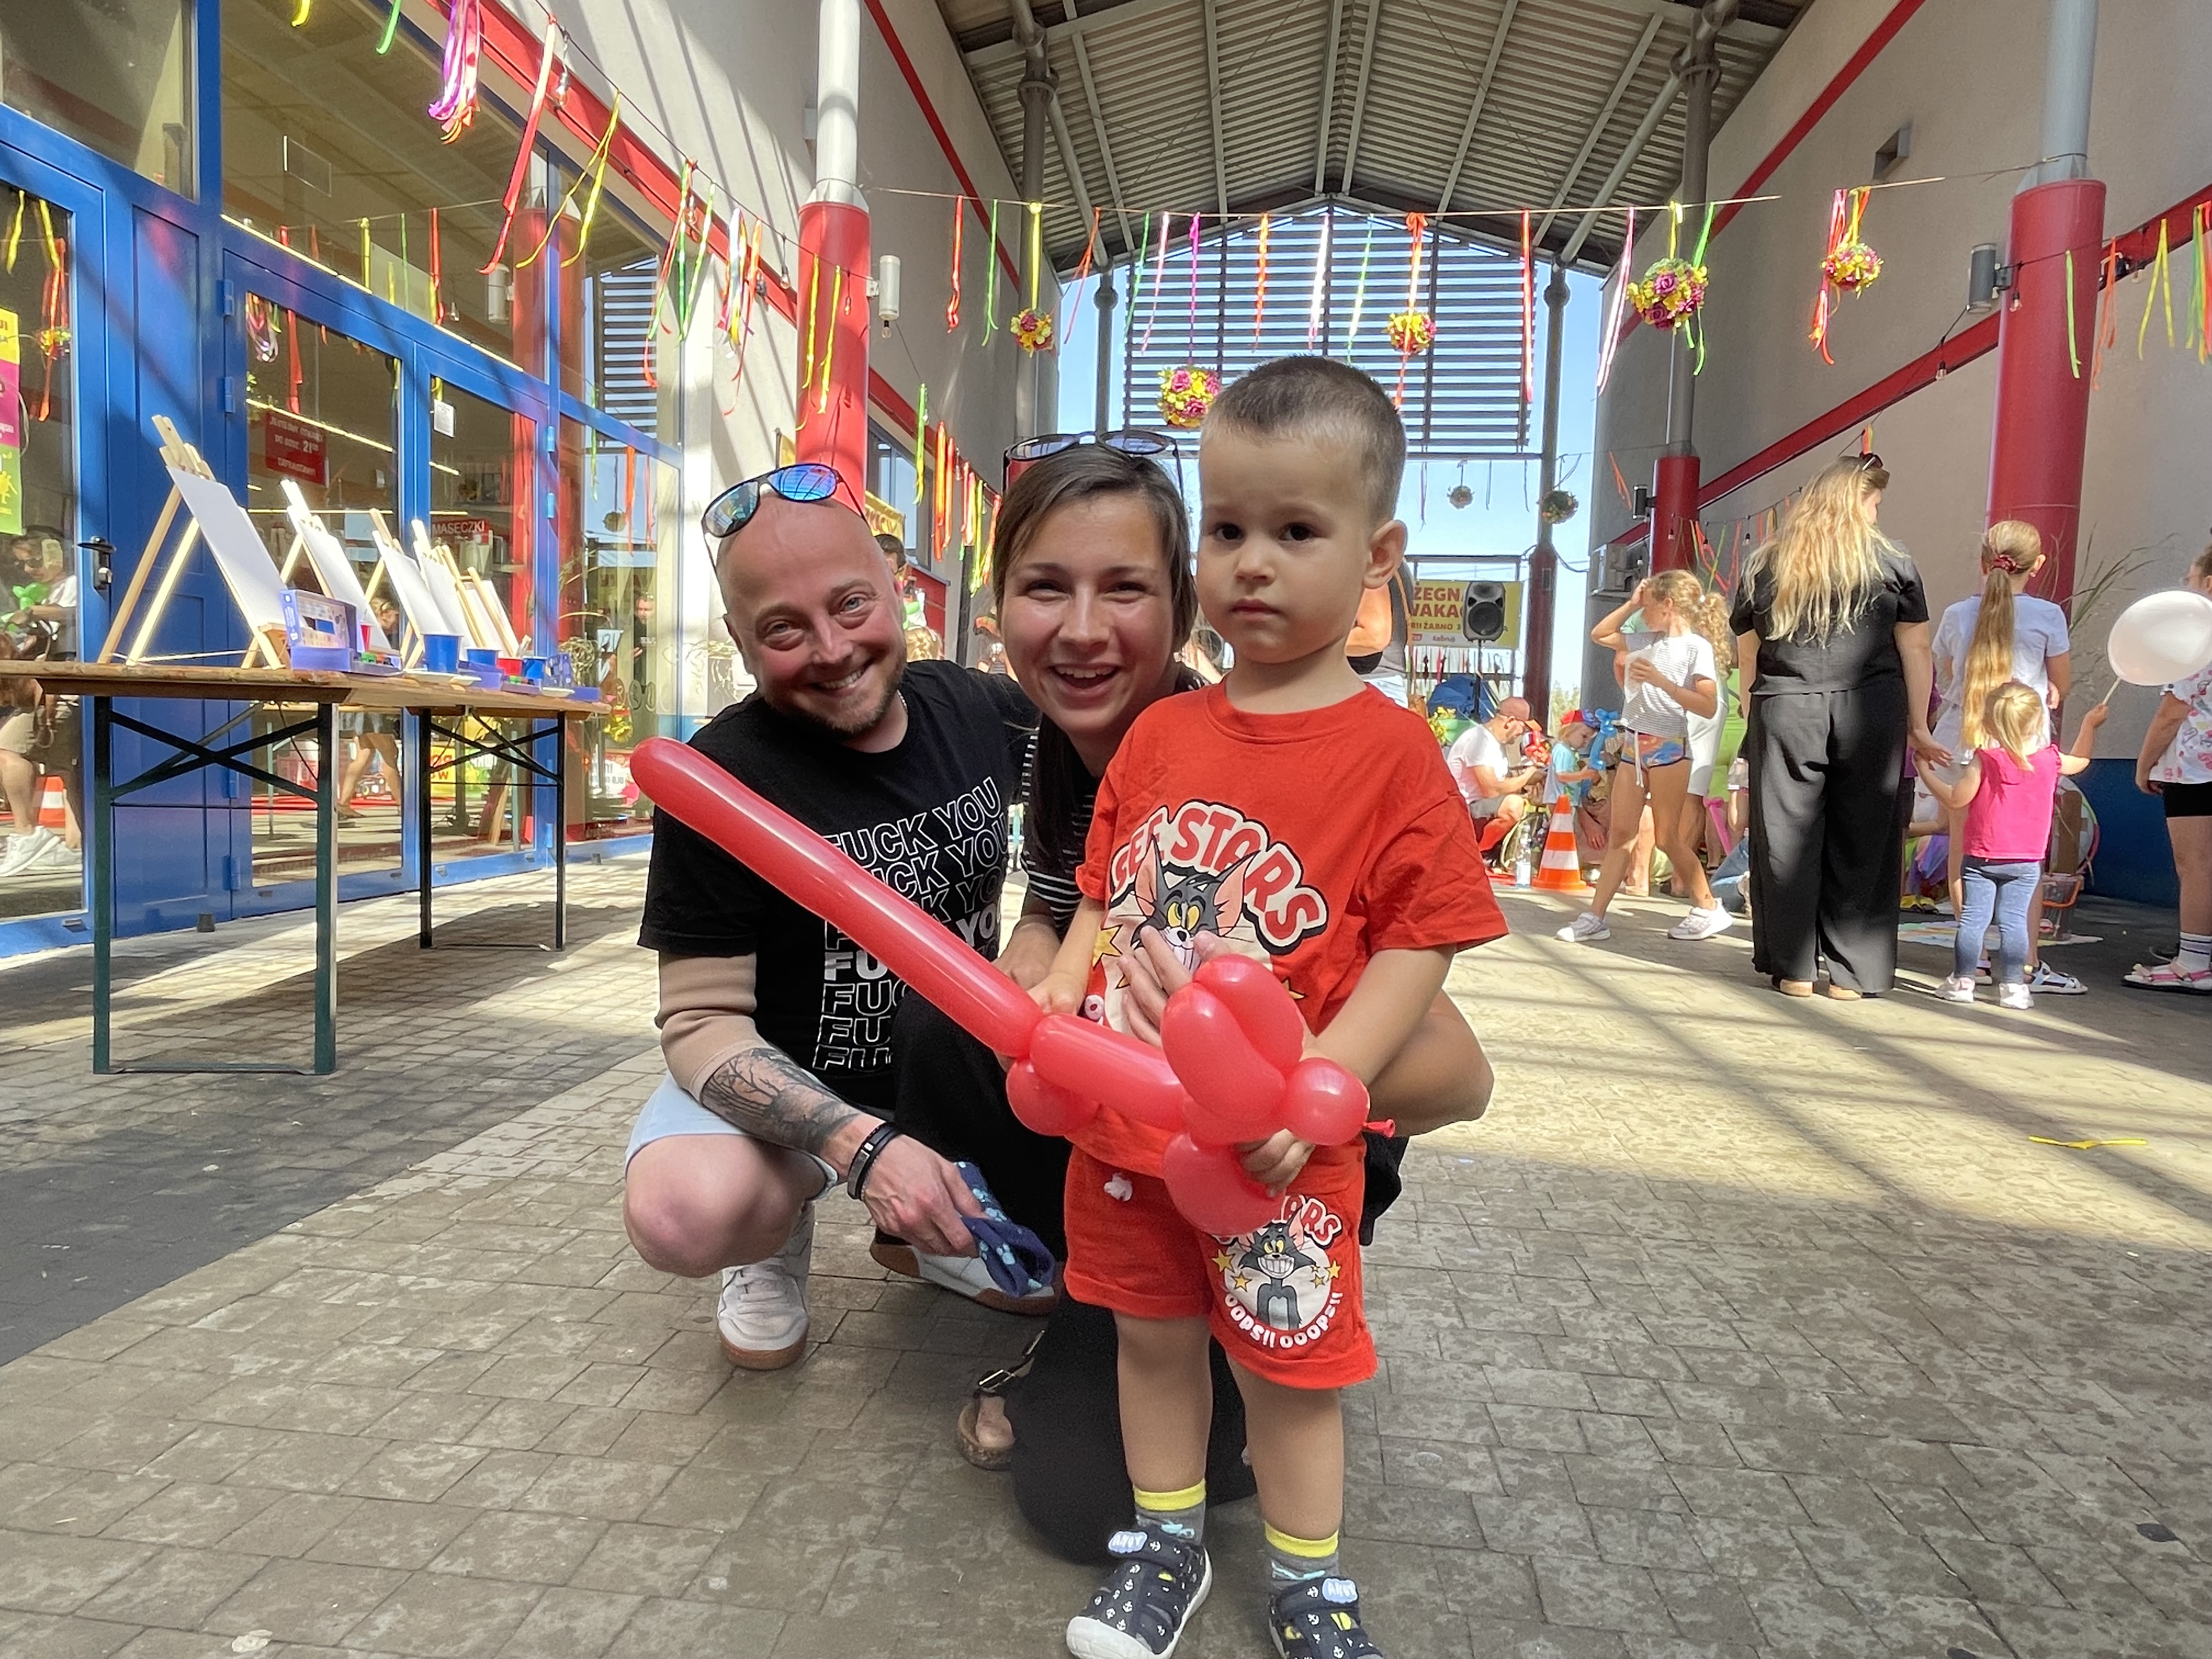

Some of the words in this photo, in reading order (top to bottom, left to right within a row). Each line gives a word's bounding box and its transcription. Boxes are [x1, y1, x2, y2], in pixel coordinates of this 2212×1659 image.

[1413, 581, 1463, 601] ŻEGN
[1423, 620, 1453, 630] ŻABNO
[932, 776, 1001, 840] YOU
[955, 866, 1005, 913] YO
[1171, 808, 1319, 940] STARS
[824, 949, 888, 981] FU
[956, 903, 997, 947] YO
[822, 979, 907, 1017] FU
[817, 1014, 891, 1047] FU
[812, 1043, 892, 1072] FU
[1283, 1196, 1339, 1242] ARS
